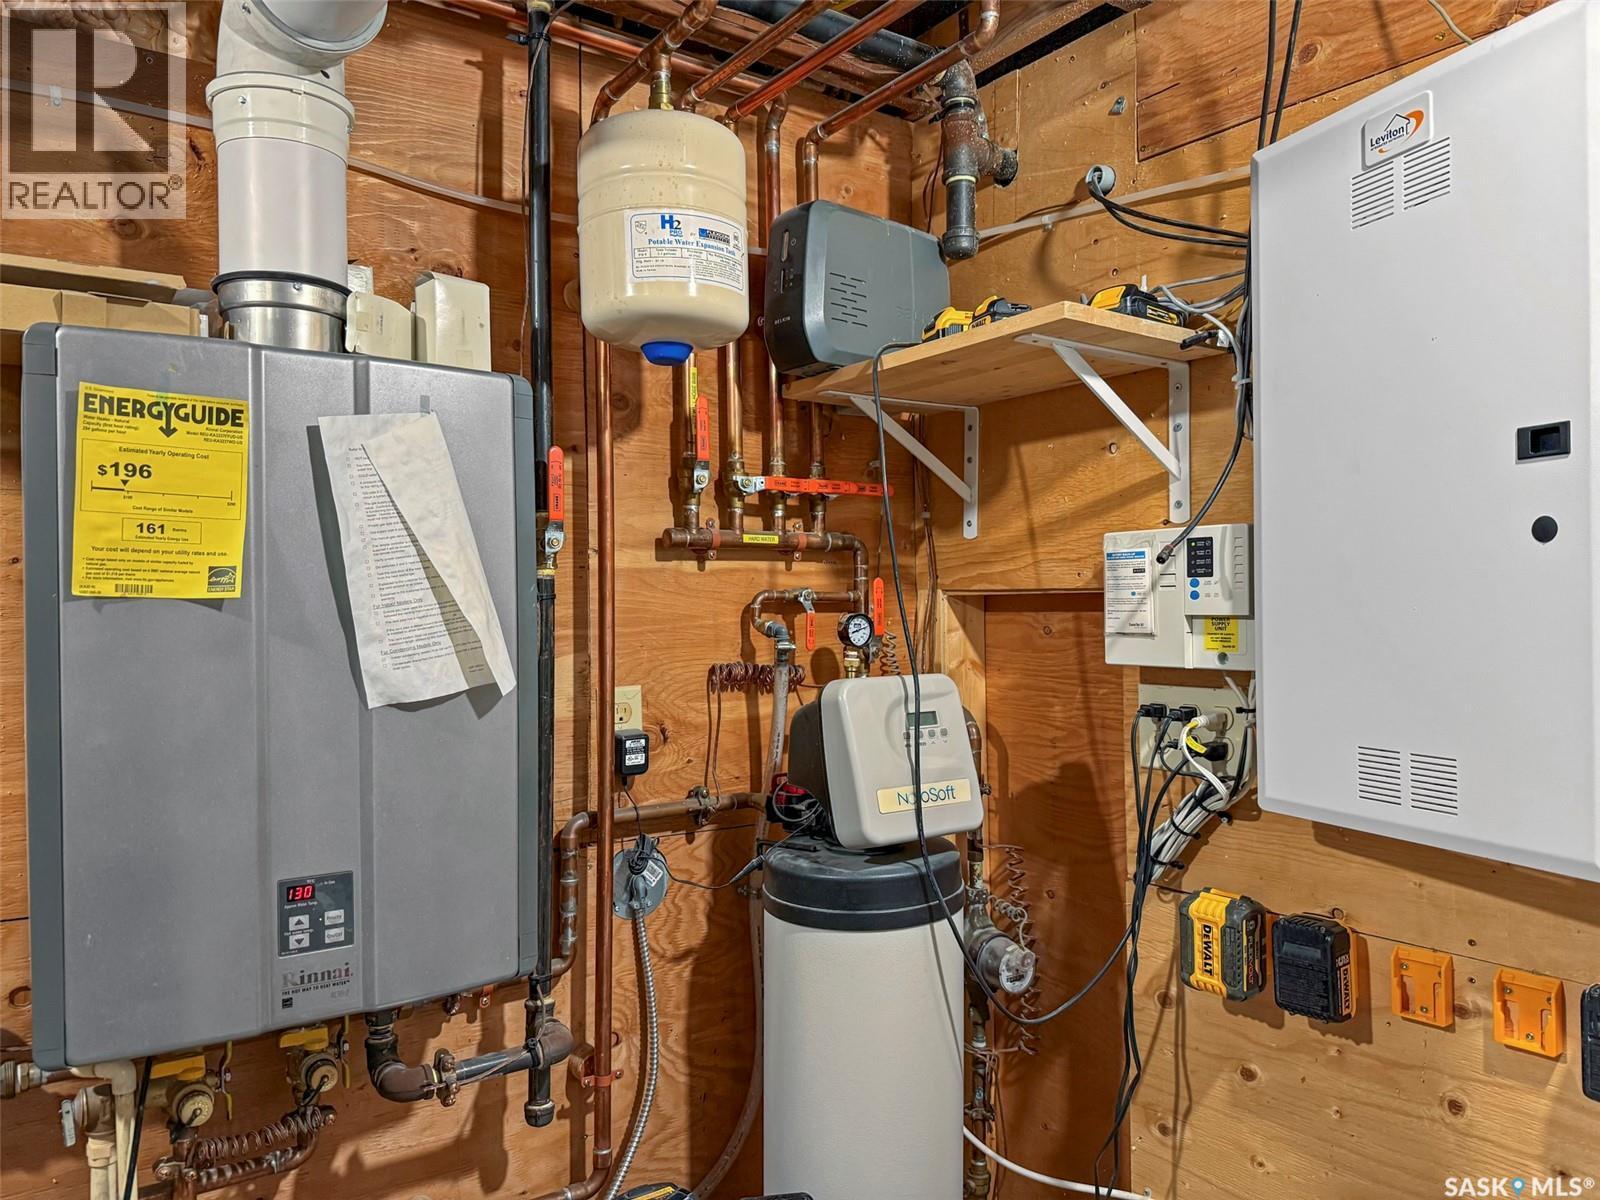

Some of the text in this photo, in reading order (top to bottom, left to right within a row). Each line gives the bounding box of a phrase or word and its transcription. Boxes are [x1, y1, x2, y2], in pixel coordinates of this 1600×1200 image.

[1370, 126, 1404, 147] Leviton
[660, 214, 682, 230] H2
[674, 238, 694, 246] Water
[696, 240, 725, 252] Expansion
[726, 247, 736, 256] Tank
[774, 316, 790, 325] BELKIN
[84, 392, 244, 429] ENERGYGUIDE
[119, 446, 148, 454] Estimated
[149, 448, 166, 456] Yearly
[167, 450, 195, 459] Operating
[98, 462, 152, 479] $196
[136, 522, 165, 534] 161
[896, 785, 956, 806] NooSoft
[289, 885, 312, 900] 130
[1203, 924, 1214, 976] DEWALT
[282, 962, 352, 986] Rinnai
